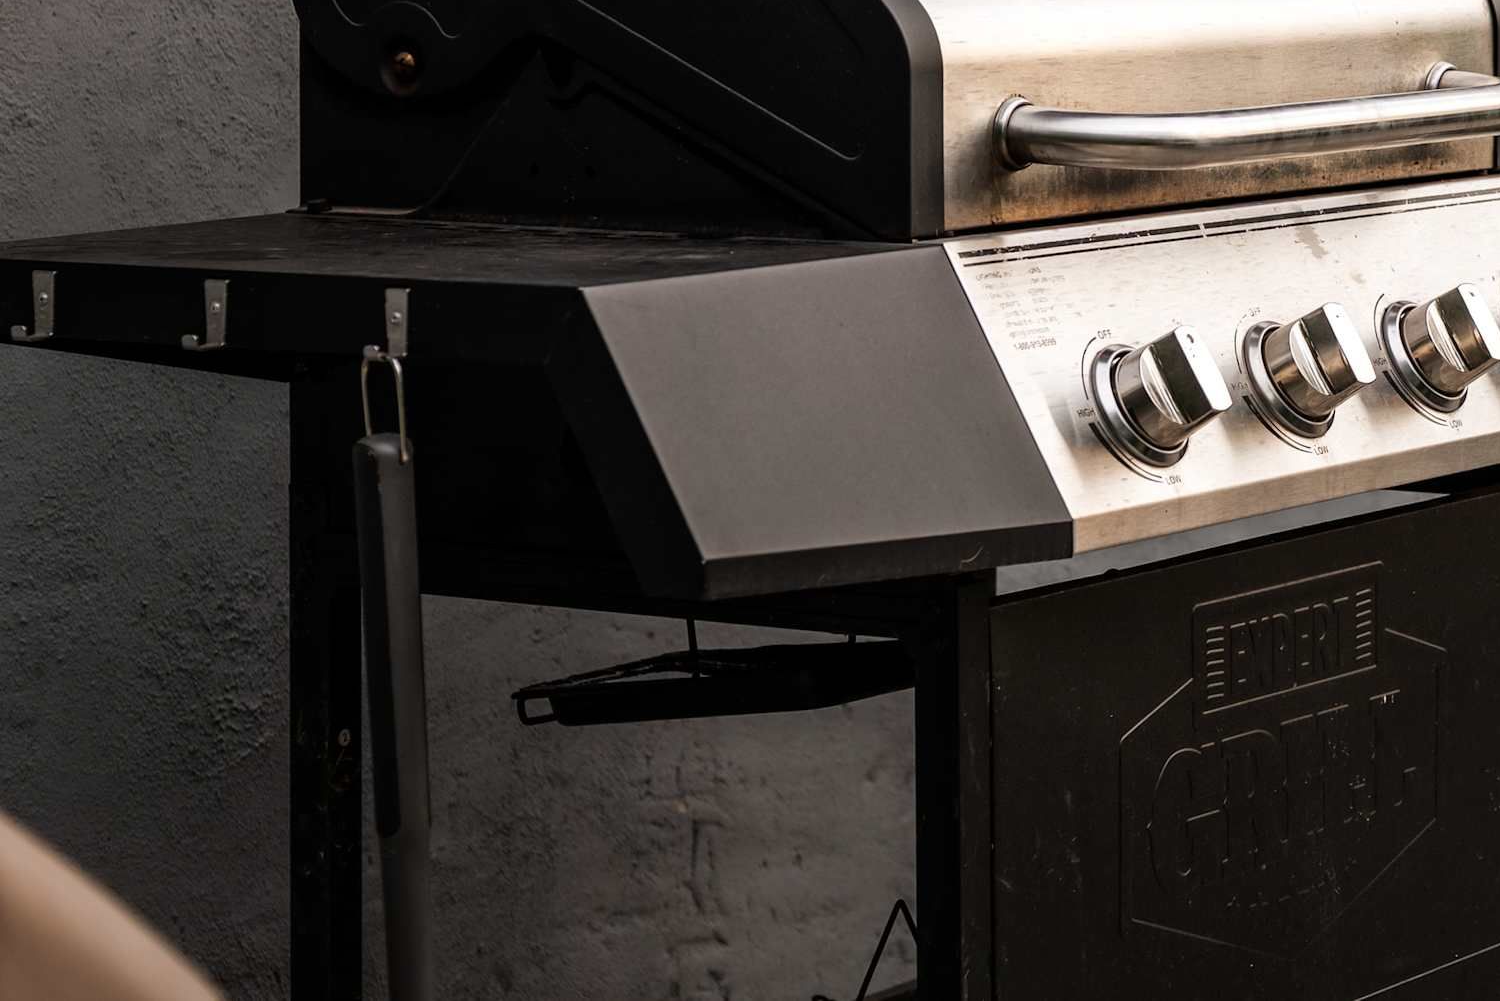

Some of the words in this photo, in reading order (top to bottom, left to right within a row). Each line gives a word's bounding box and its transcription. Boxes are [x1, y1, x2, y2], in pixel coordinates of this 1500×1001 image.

[1097, 329, 1112, 340] OFF
[1076, 408, 1096, 419] HIGH
[1313, 444, 1329, 456] LOW
[1166, 475, 1182, 486] LOW
[1230, 596, 1350, 696] EXPERT
